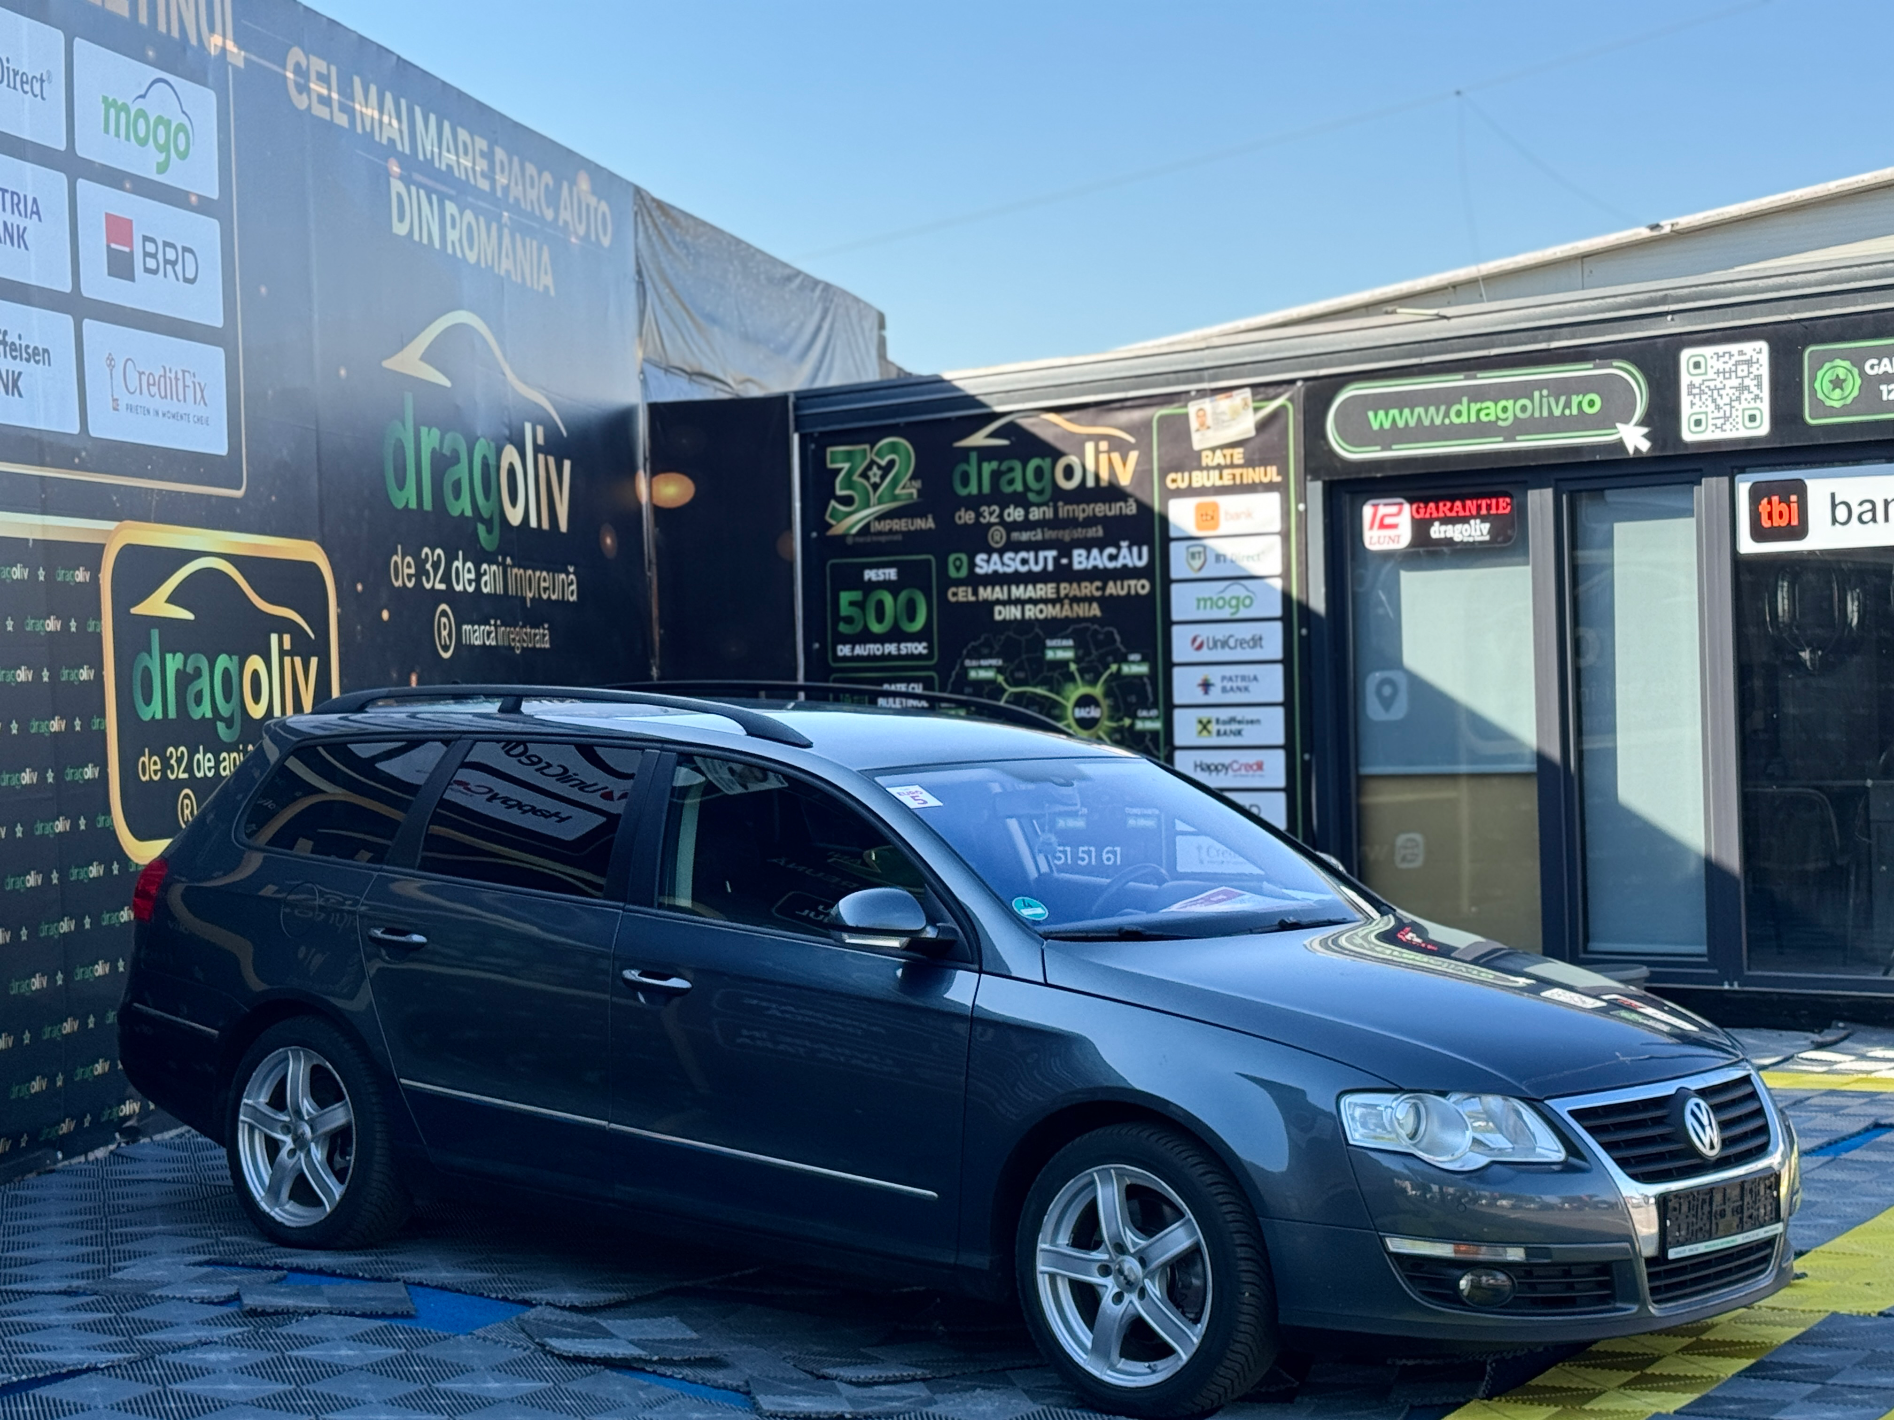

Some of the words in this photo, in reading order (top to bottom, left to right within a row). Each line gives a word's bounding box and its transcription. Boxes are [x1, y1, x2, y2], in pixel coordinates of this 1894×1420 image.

[102, 94, 191, 175] mogo
[285, 46, 349, 129] CEL
[352, 74, 411, 155] MAI
[413, 104, 491, 193] MARE
[494, 145, 555, 222] PARC
[558, 179, 613, 249] AUTO
[0, 220, 29, 251] NK
[389, 175, 441, 251] DIN
[444, 198, 556, 298] ROMÂNIA
[141, 234, 199, 285] BRD
[1864, 356, 1894, 376] GA
[122, 357, 208, 408] CreditFix
[1367, 389, 1602, 431] www.dragoliv.ro
[1201, 448, 1245, 467] RATE
[383, 391, 571, 552] dragoliv
[825, 437, 915, 526] 32
[952, 440, 1139, 503] dragoliv
[1165, 472, 1189, 490] CU
[1191, 465, 1282, 488] BULETINUL
[955, 507, 975, 525] de
[979, 504, 1000, 524] 32
[1003, 504, 1025, 522] de
[1028, 502, 1054, 521] ani
[1057, 497, 1137, 521] împreună
[1368, 504, 1404, 531] 12
[1411, 497, 1512, 519] GARANTIE
[1758, 494, 1799, 529] tbi
[1010, 528, 1043, 542] marcă
[1368, 534, 1401, 546] LUNI
[1430, 519, 1491, 541] dragoliv
[974, 550, 1057, 575] SASCUT
[1072, 540, 1149, 570] BACĂU
[56, 566, 90, 586] dragoliv
[390, 544, 416, 589] de
[421, 546, 447, 591] 32
[451, 549, 476, 594] de
[480, 555, 504, 597] ani
[505, 556, 578, 608] împreună
[863, 568, 898, 581] PESTE
[947, 586, 976, 602] CEL
[978, 585, 1009, 601] MAI
[1010, 583, 1057, 600] MARE
[1059, 581, 1103, 597] PARC
[1104, 578, 1150, 596] AUTO
[837, 587, 928, 635] 500
[994, 605, 1022, 621] DIN
[1024, 598, 1102, 620] ROMÂNIA
[1195, 594, 1254, 617] mogo
[24, 615, 61, 636] dragoliv
[461, 619, 496, 648] marcă
[837, 644, 852, 657] DE
[853, 644, 883, 656] AUTO
[884, 643, 899, 656] PE
[899, 642, 929, 655] STOC
[1206, 634, 1264, 651] UniCredit
[60, 665, 95, 685] dragoliv
[132, 628, 319, 743] dragoliv
[1220, 674, 1259, 684] PATRIA
[1220, 685, 1251, 694] BANK
[30, 716, 66, 736] dragoliv
[1215, 728, 1245, 738] BANK
[138, 747, 162, 782] de
[166, 745, 190, 780] 32
[193, 745, 215, 779] de
[1194, 760, 1264, 776] HappyCredit
[1077, 846, 1096, 866] 51
[1102, 846, 1122, 866] 61
